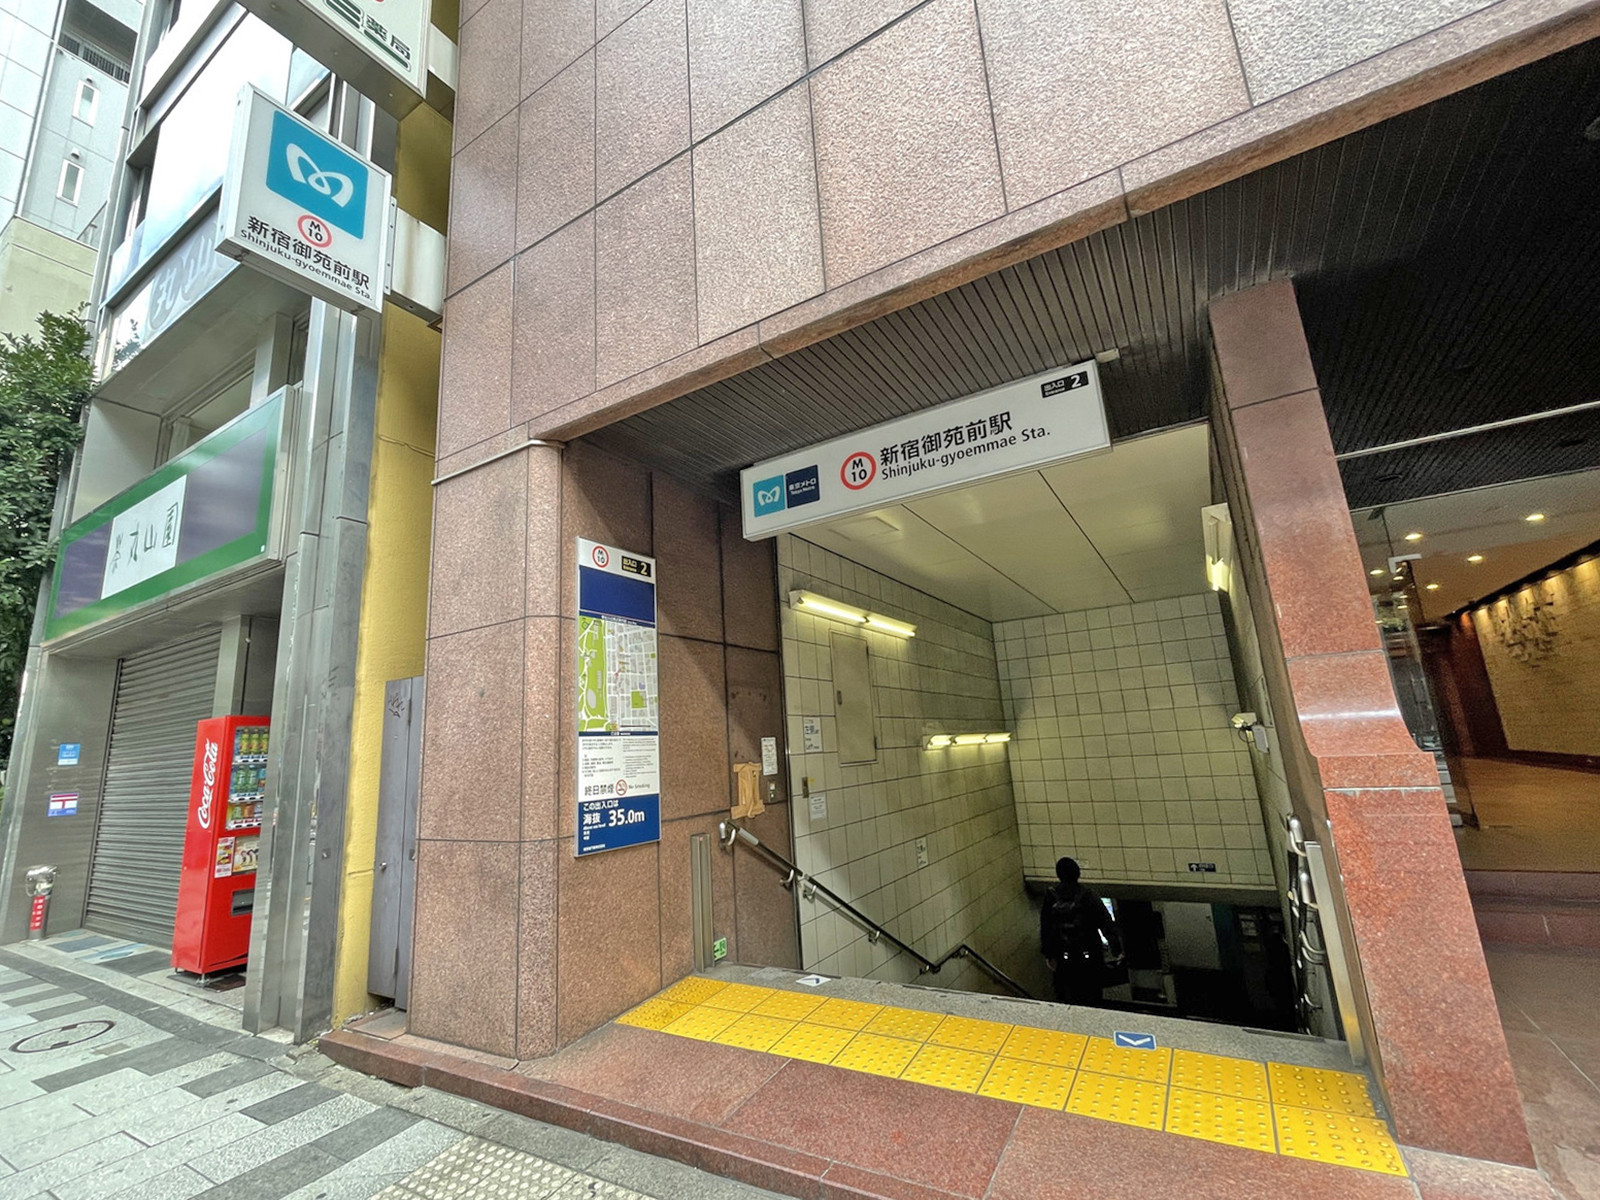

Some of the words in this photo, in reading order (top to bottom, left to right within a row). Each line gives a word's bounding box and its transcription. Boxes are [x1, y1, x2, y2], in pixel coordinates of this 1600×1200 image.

[366, 14, 411, 60] 薬局
[309, 221, 321, 232] M
[308, 228, 323, 242] 10
[247, 215, 370, 290] 新宿御苑前駅
[240, 229, 353, 291] Shinjuku-gyoemmae
[355, 286, 372, 301] Sta.
[1070, 374, 1082, 388] 2
[879, 411, 1013, 467] 新宿御苑前駅
[881, 432, 1017, 481] Shinjuku-gyoemmae
[1021, 424, 1051, 441] Sta.
[851, 458, 864, 470] M
[851, 469, 868, 482] 10
[788, 478, 816, 491] 東京メトロ
[596, 555, 605, 564] 10
[640, 562, 647, 575] 2
[198, 738, 218, 829] Coca-Cola
[583, 800, 619, 812] この出入口は
[583, 812, 600, 825] 海抜
[608, 808, 645, 827] 35.0m
